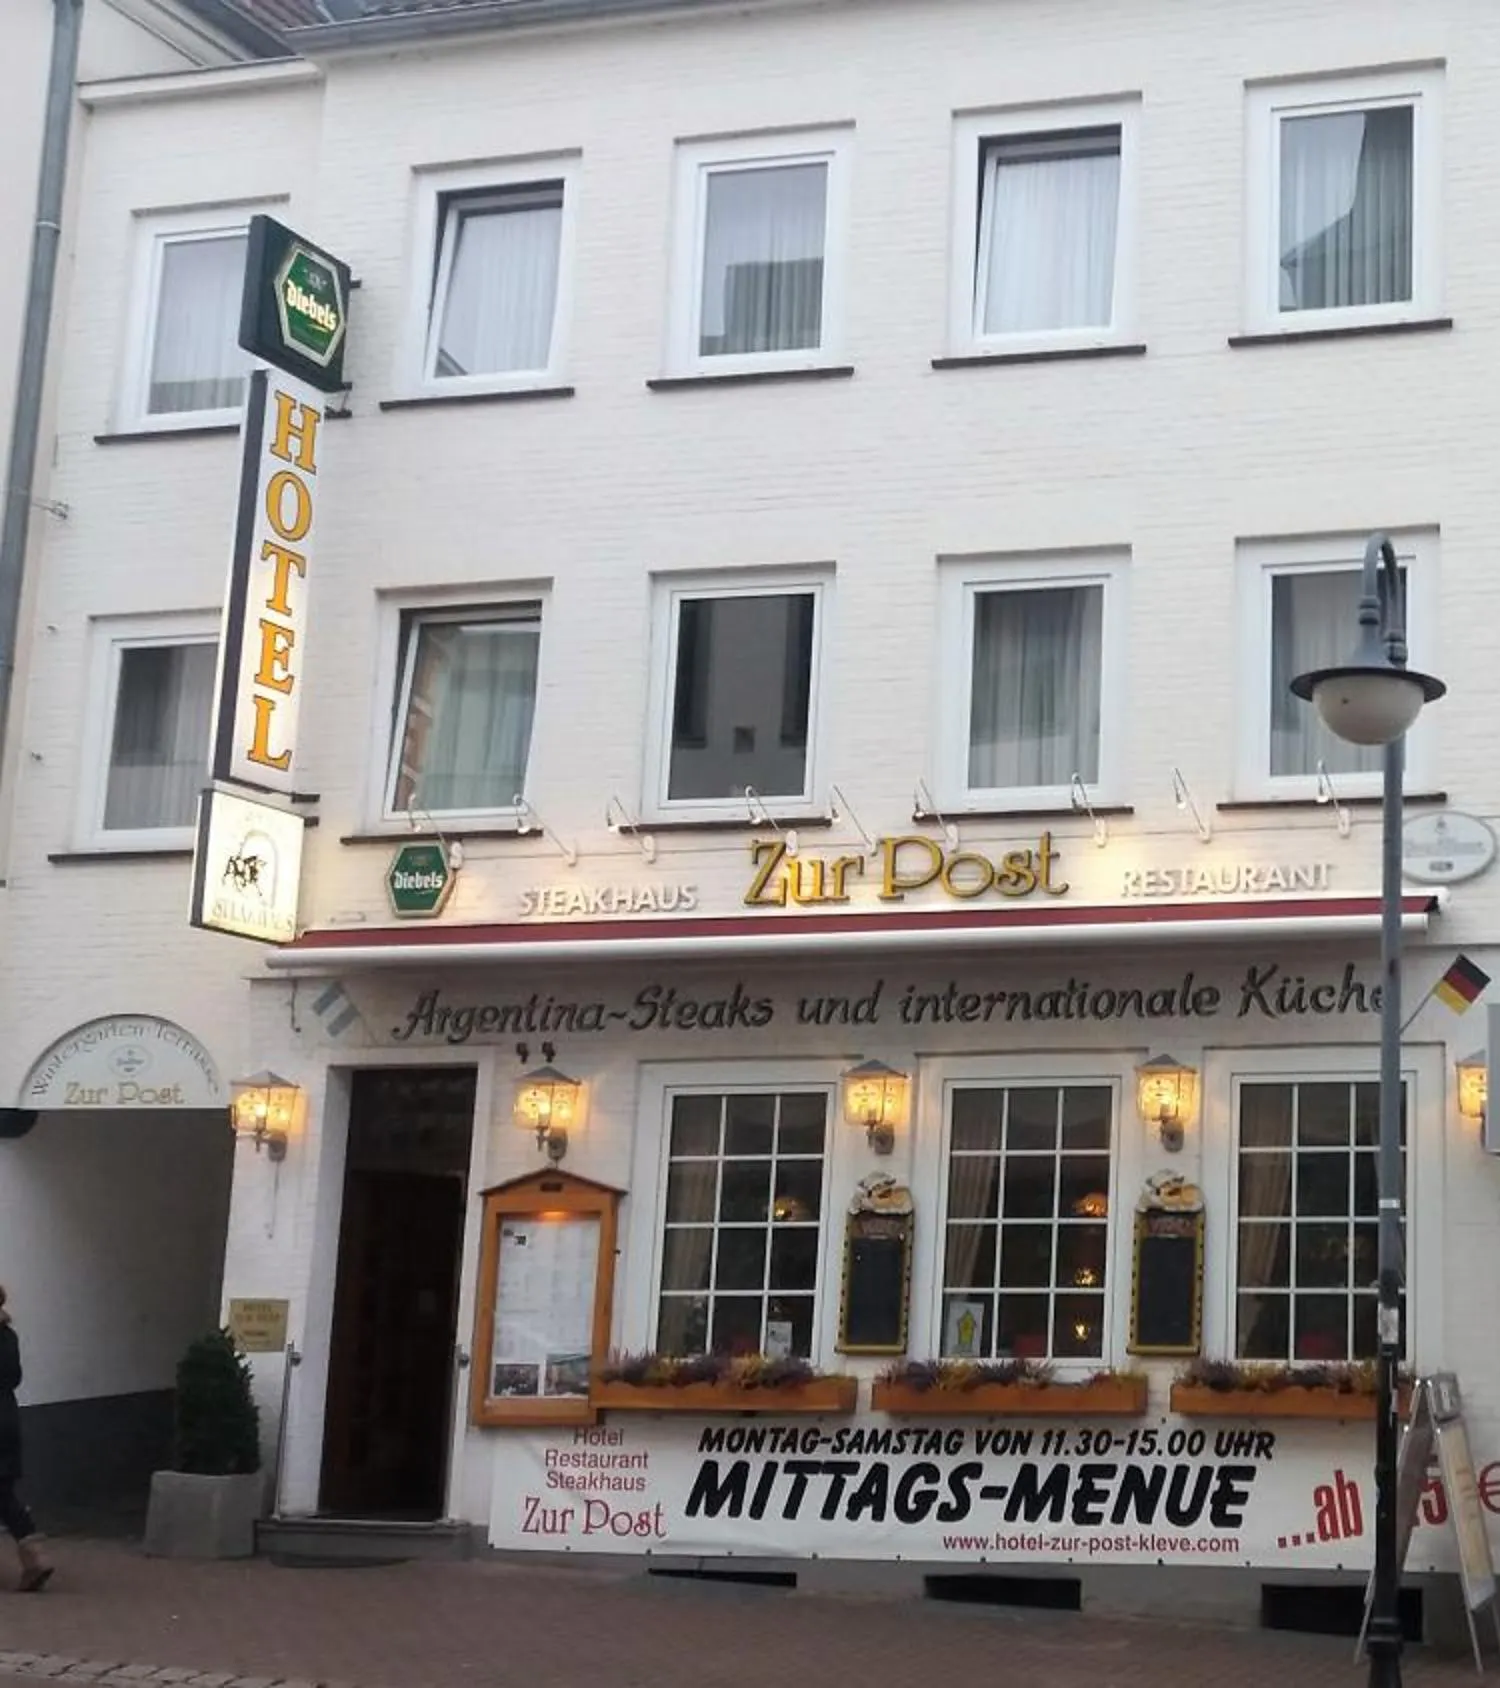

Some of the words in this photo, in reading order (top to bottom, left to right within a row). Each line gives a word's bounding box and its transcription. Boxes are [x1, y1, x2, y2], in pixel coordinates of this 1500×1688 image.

[286, 278, 338, 332] Diebels
[246, 389, 323, 773] HOTEL
[393, 870, 444, 890] Diebels
[742, 838, 866, 907] Zur
[876, 830, 1072, 902] Post
[1120, 862, 1334, 898] RESTAURANT
[518, 882, 698, 917] STEAKHAUS
[392, 981, 774, 1045] Argentina-Steaks
[796, 979, 886, 1026] und
[900, 970, 1221, 1025] internationale
[63, 1081, 109, 1105] Zur
[115, 1080, 186, 1105] Post
[572, 1425, 625, 1448] Hotel
[698, 1426, 964, 1457] MONTAG-SAMSTAG
[973, 1427, 1030, 1457] VON
[1039, 1427, 1204, 1458] 11.30-15.00
[1213, 1430, 1276, 1461] UHR
[544, 1449, 649, 1471] Restaurant
[546, 1470, 646, 1492] Steakhaus
[684, 1460, 1257, 1529] MITTAGS-MENUE
[522, 1497, 576, 1536] Zur
[582, 1498, 669, 1540] Post
[942, 1530, 1241, 1555] www.hotel-zur-post-kleve.com
